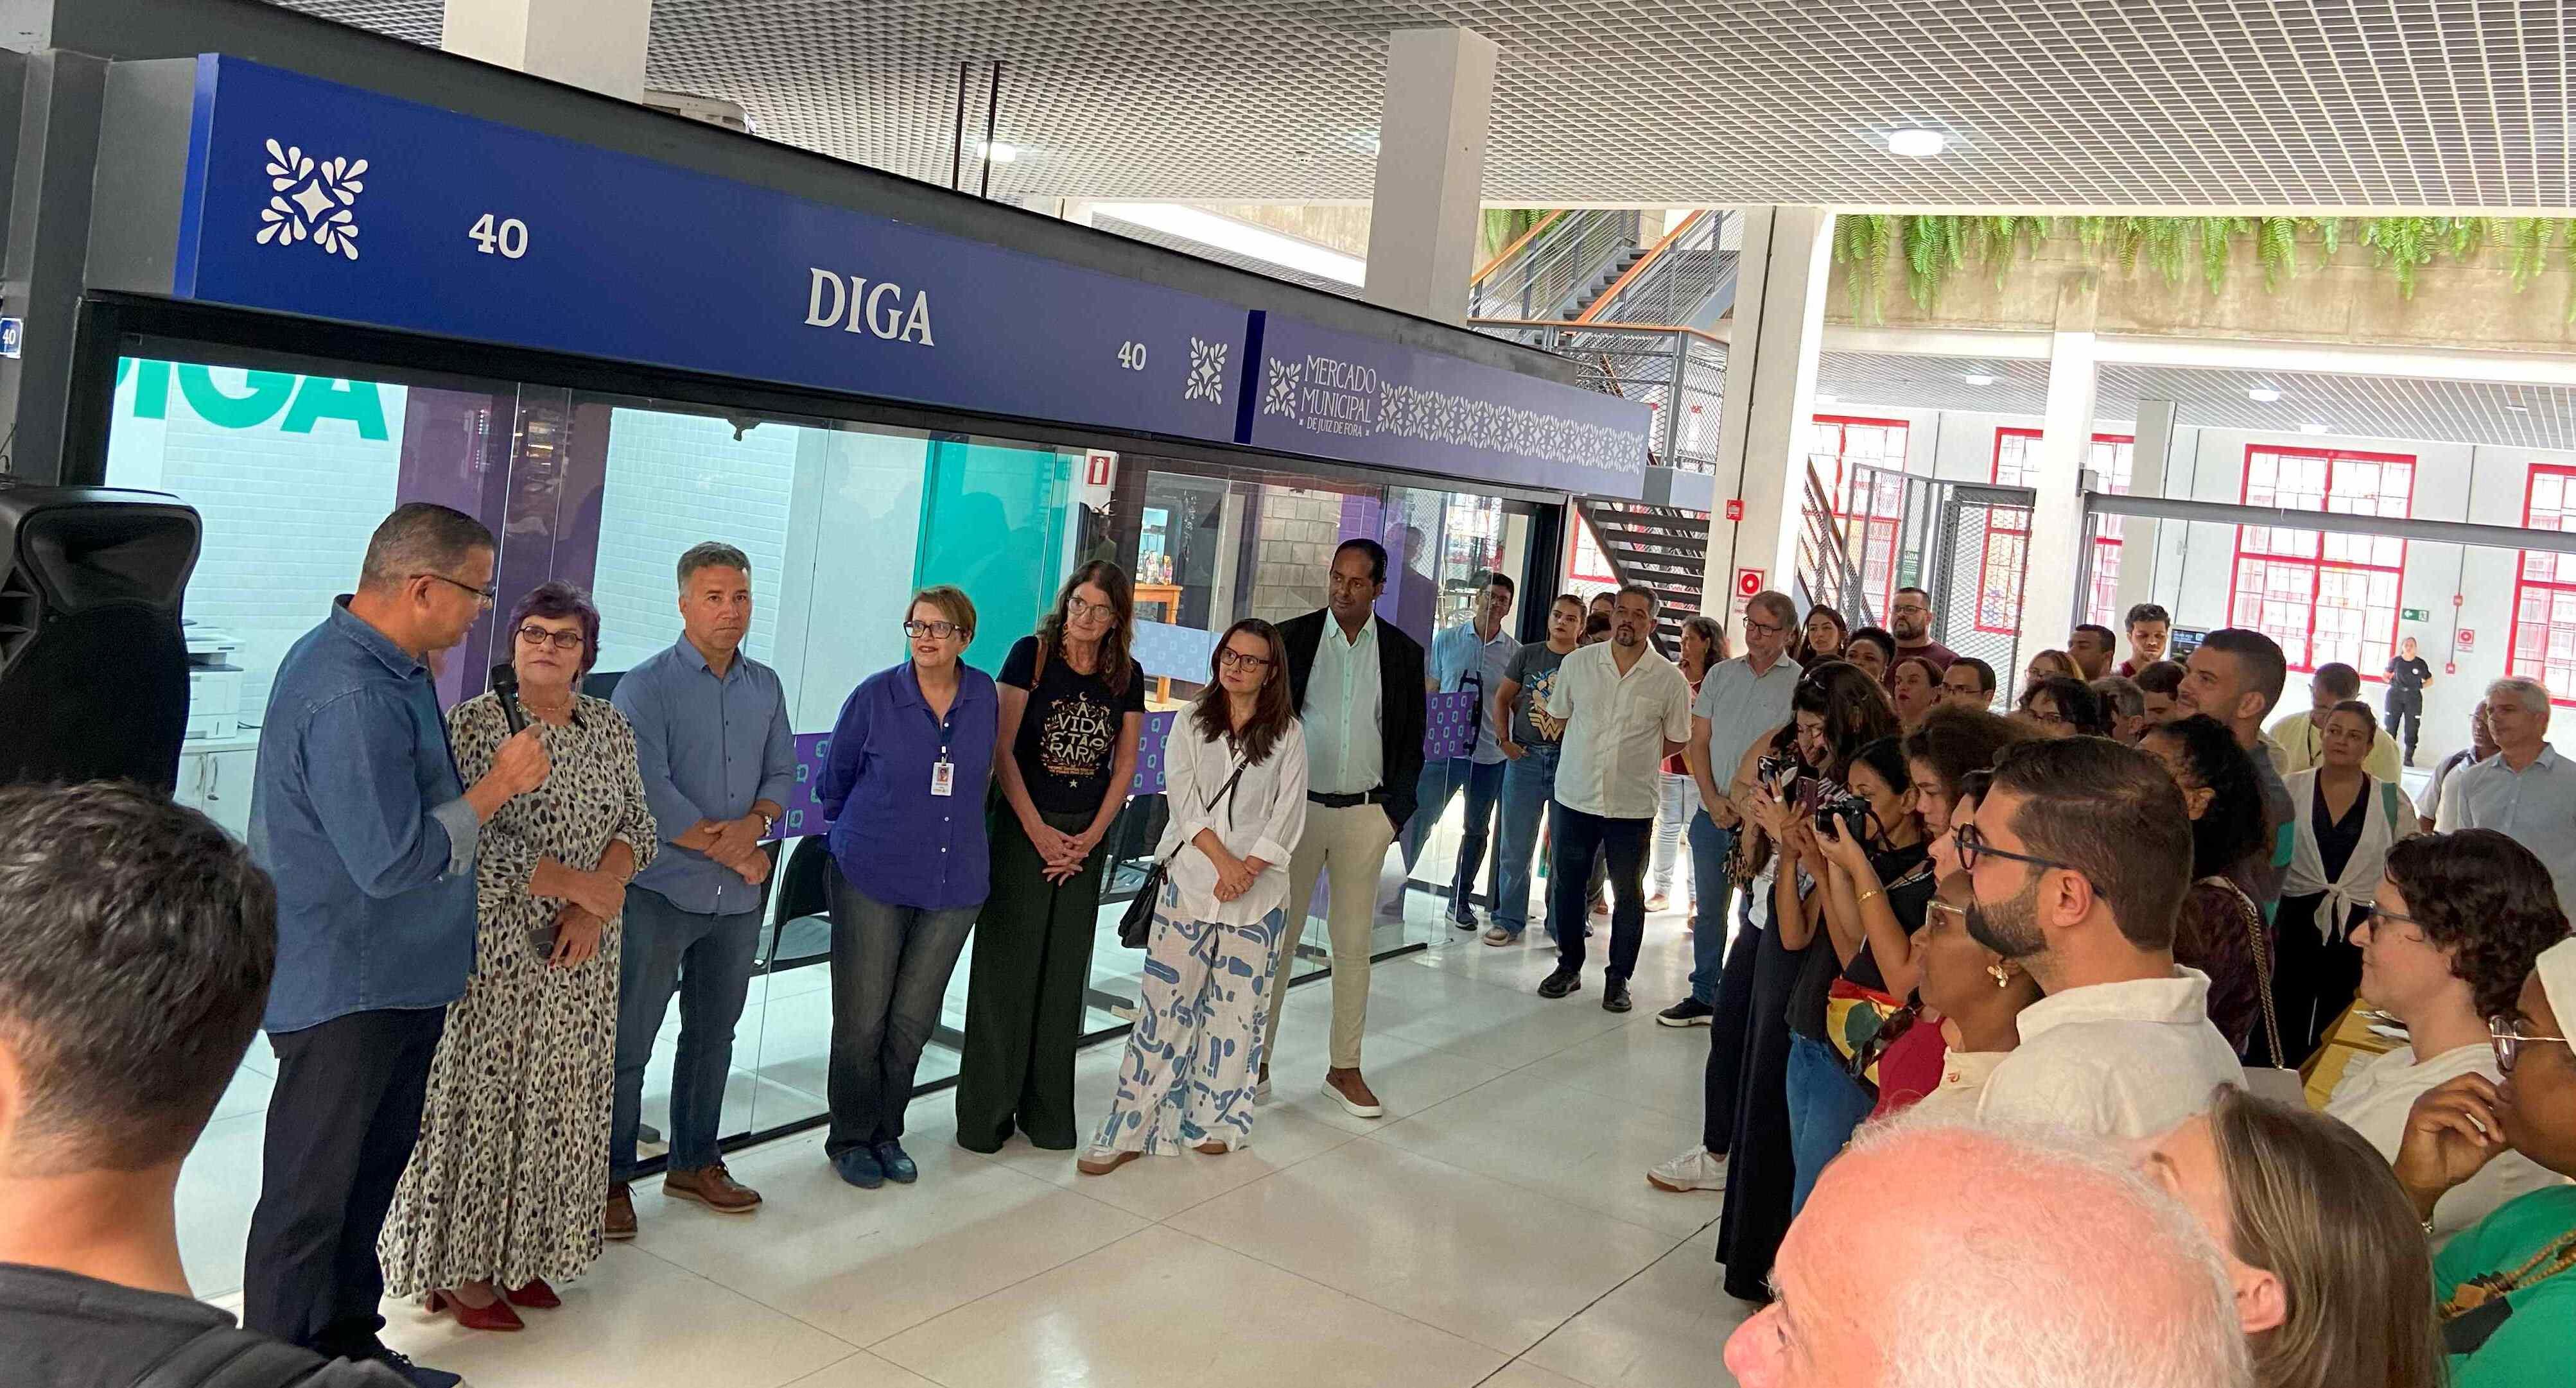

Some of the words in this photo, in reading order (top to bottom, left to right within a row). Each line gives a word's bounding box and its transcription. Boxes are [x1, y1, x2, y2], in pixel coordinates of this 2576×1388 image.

[468, 213, 528, 259] 40
[804, 267, 935, 347] DIGA
[2, 328, 17, 345] 40
[1117, 341, 1147, 370] 40
[1305, 354, 1377, 394] MERCADO
[117, 356, 390, 442] IGA
[1301, 386, 1371, 423] MUNICIPAL
[1307, 416, 1318, 430] DE
[1316, 418, 1333, 434] JUIZ
[1334, 421, 1344, 434] DE
[1344, 422, 1362, 437] FORA
[1076, 702, 1089, 717] A
[1057, 713, 1108, 737] VIDA
[1049, 742, 1096, 763] RARA
